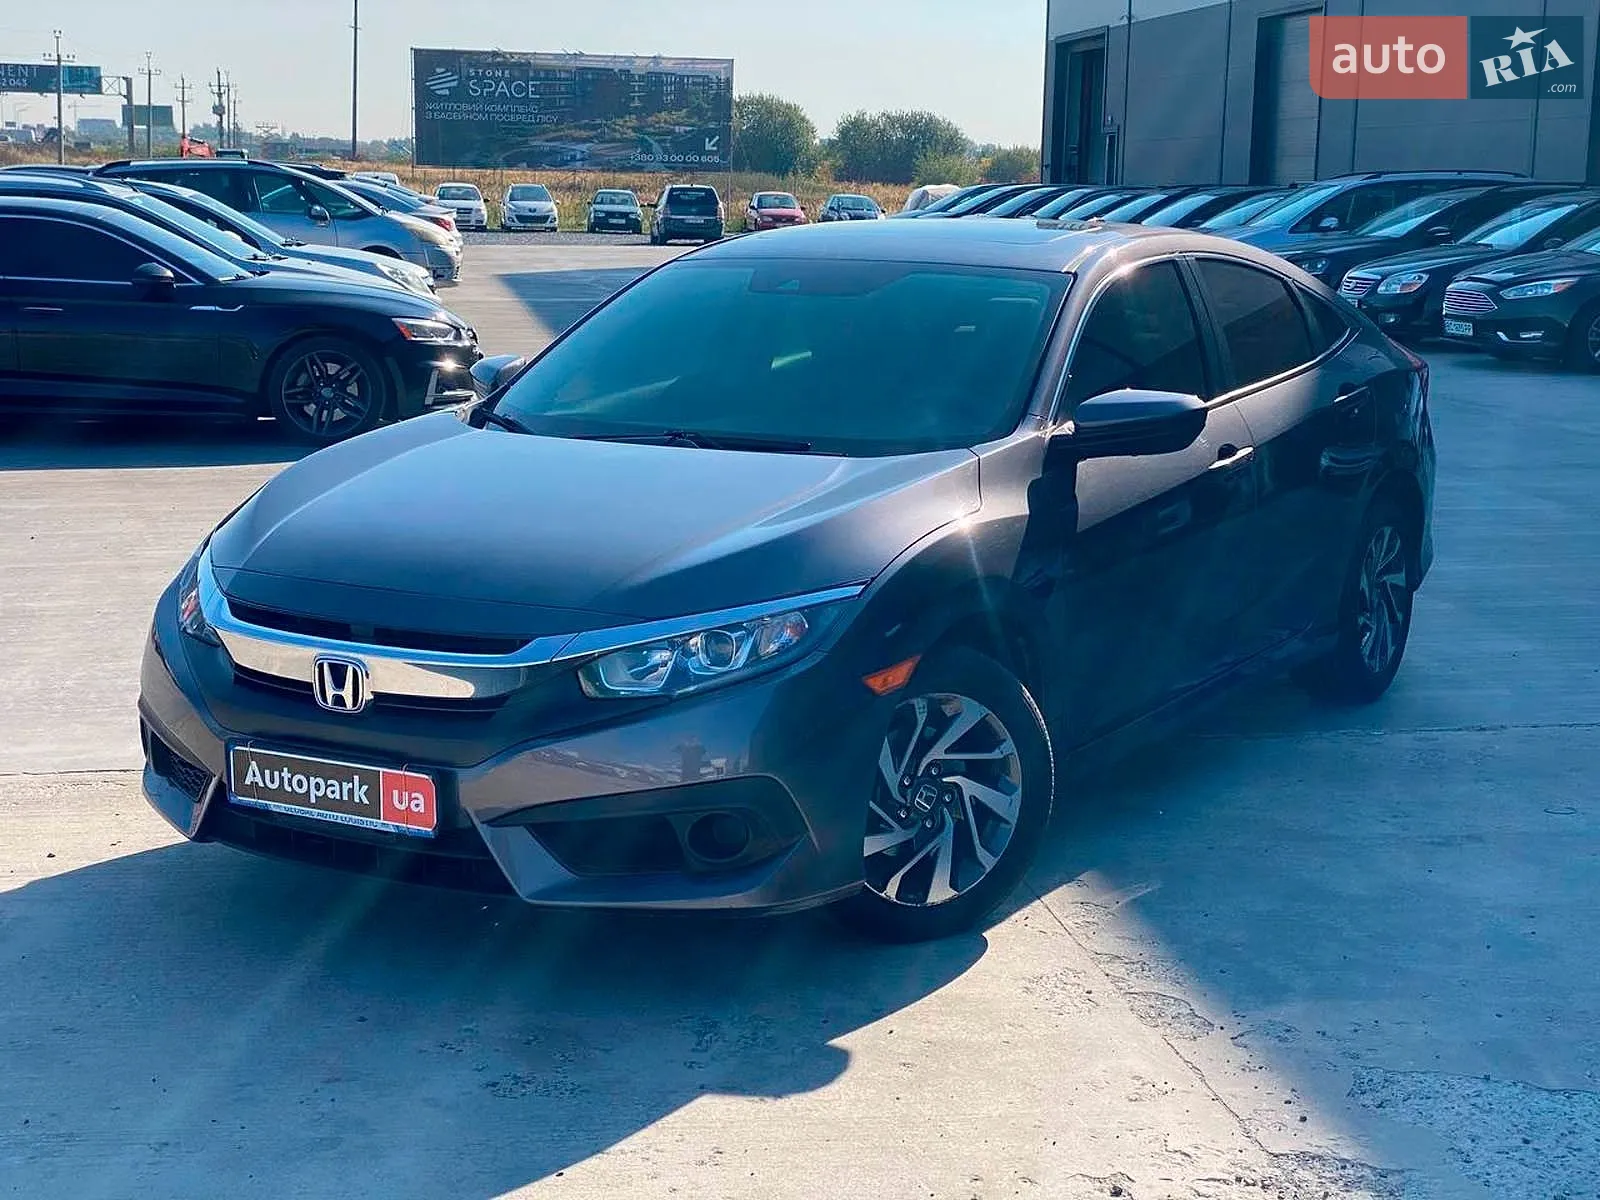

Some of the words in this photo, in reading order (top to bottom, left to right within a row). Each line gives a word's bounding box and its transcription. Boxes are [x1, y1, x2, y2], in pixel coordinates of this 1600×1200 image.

[469, 69, 511, 78] STONE
[469, 80, 540, 98] SPACE
[244, 760, 370, 805] Autopark
[392, 789, 425, 814] ua
